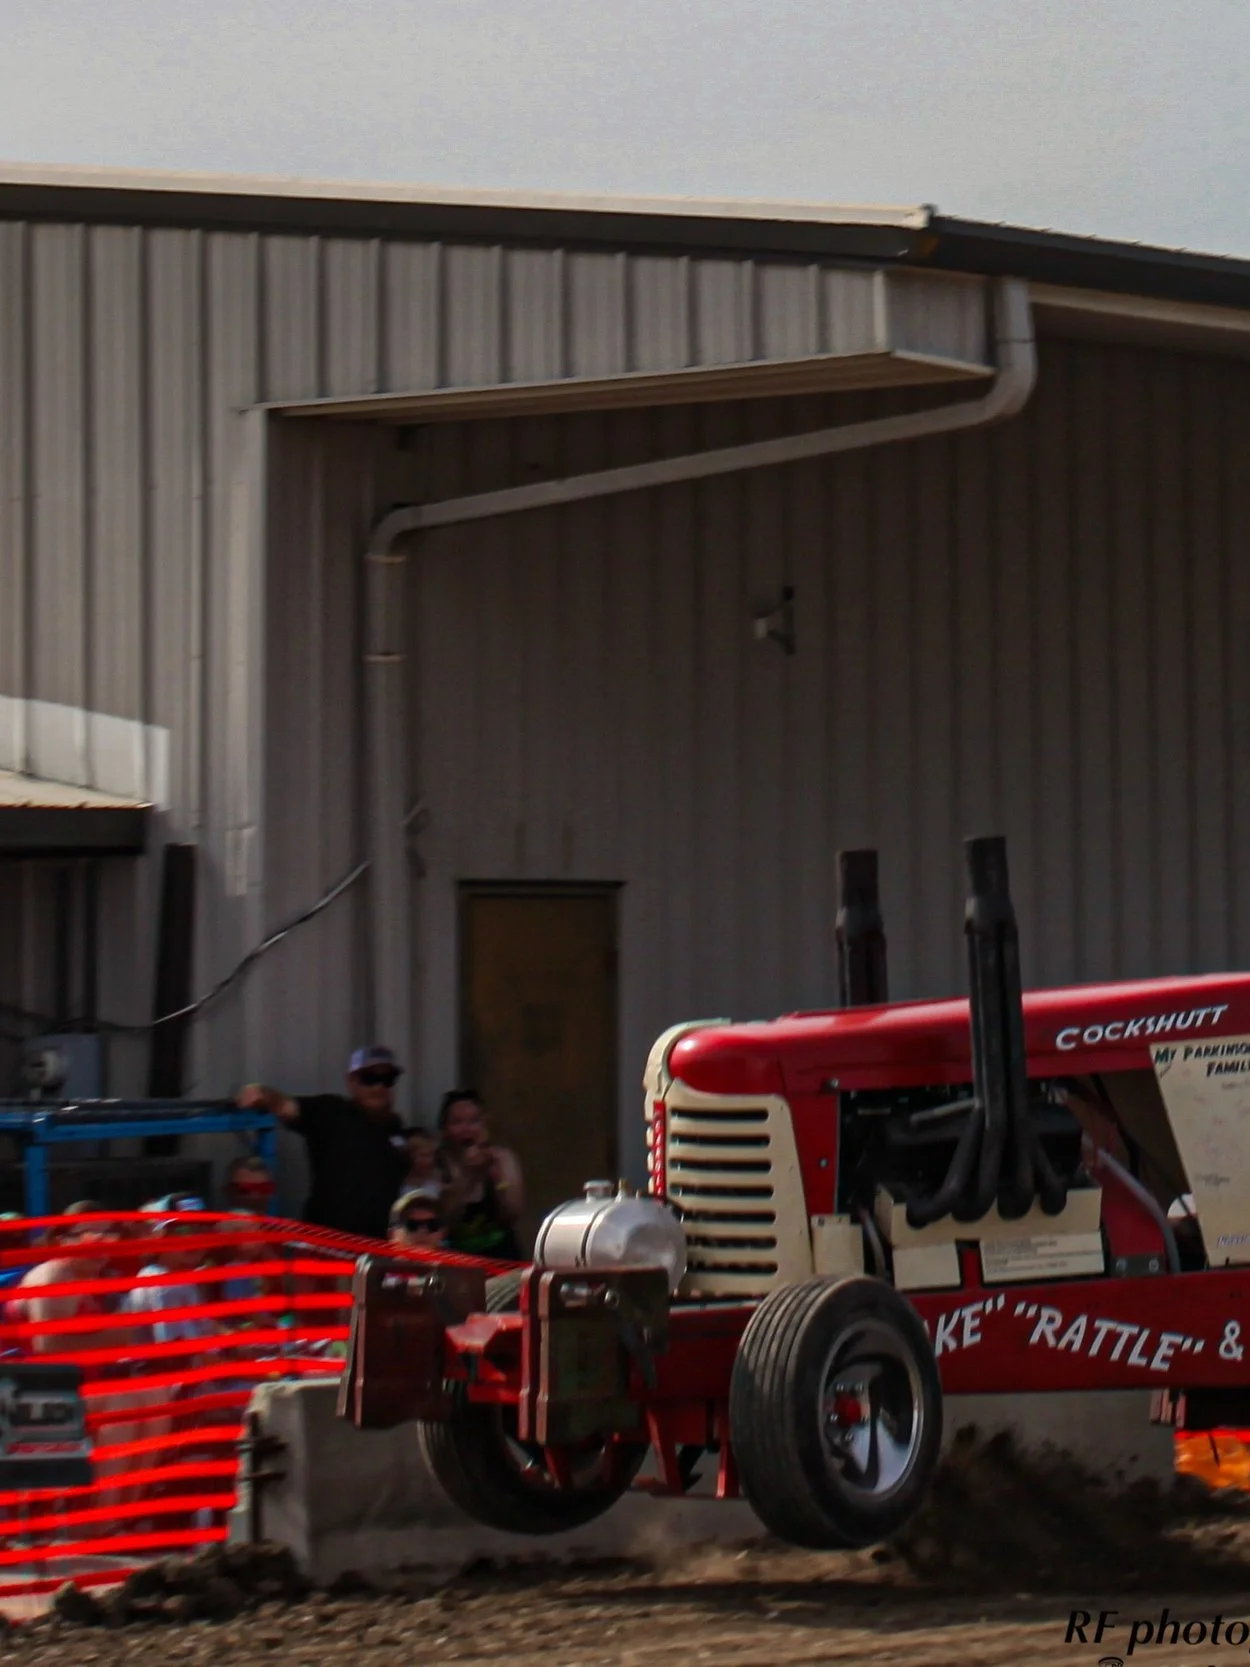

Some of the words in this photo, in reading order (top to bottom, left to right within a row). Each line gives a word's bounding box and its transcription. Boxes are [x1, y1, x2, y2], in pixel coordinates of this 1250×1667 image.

[1055, 1003, 1229, 1051] COCKSHUTT
[1013, 1301, 1205, 1372] "RATTLE"
[1218, 1320, 1244, 1362] &
